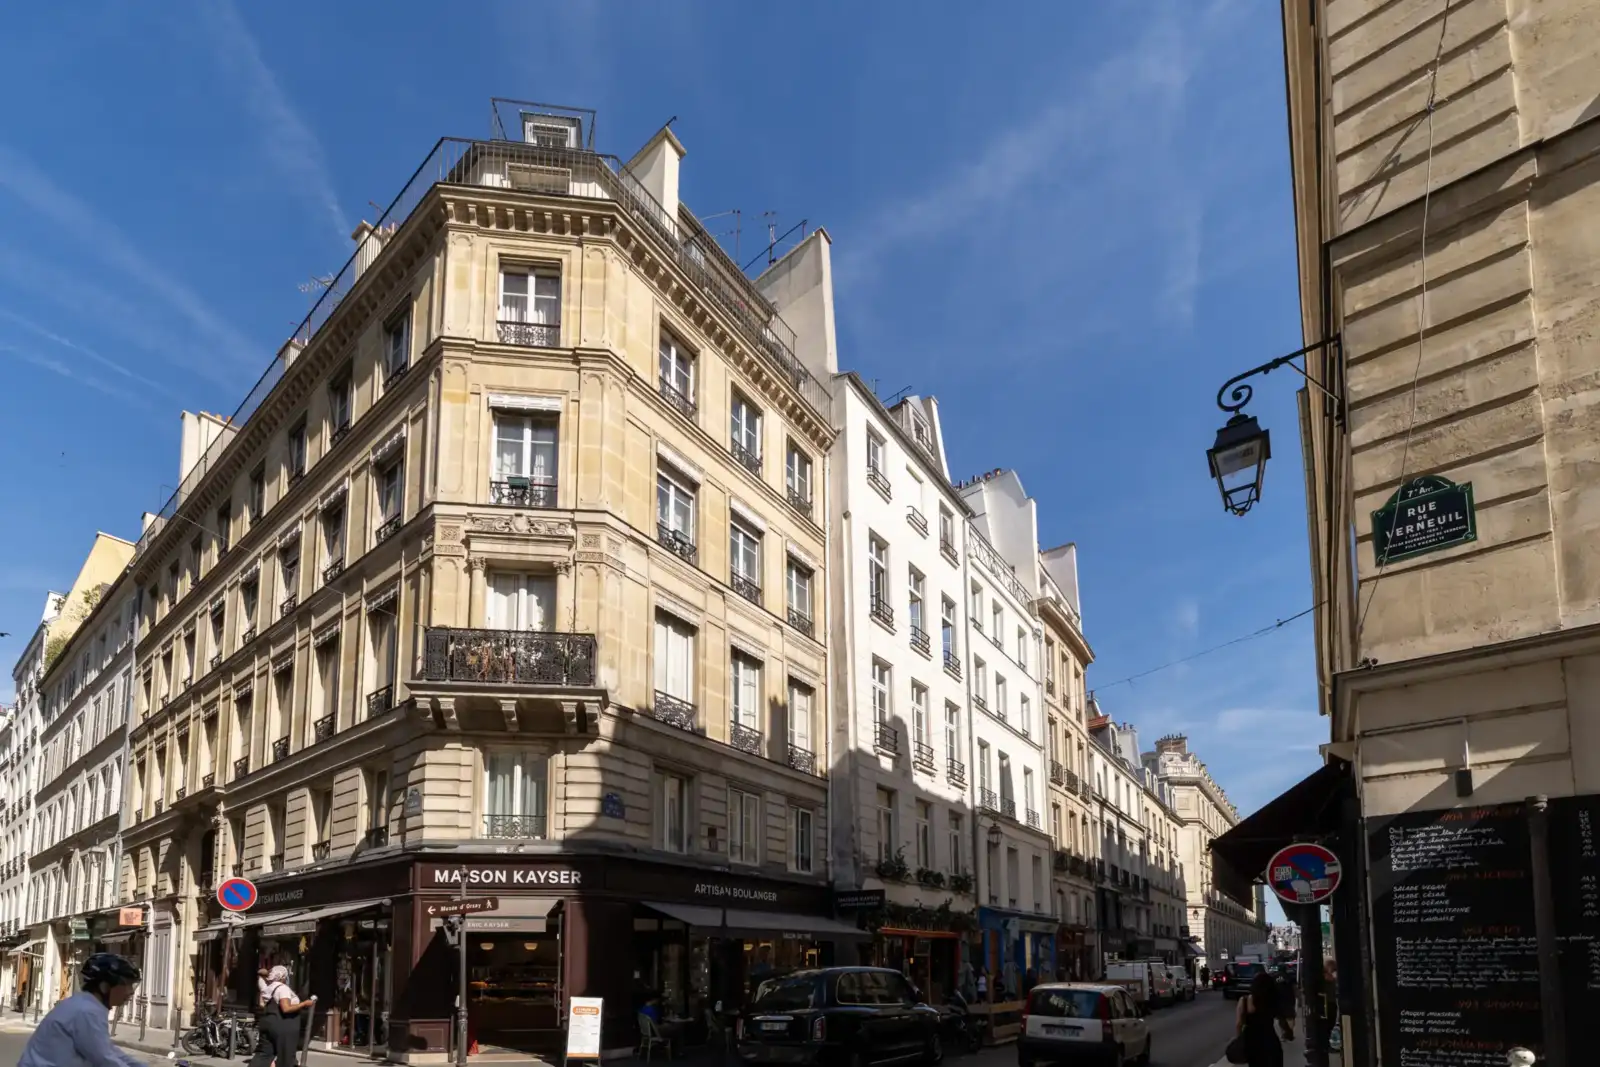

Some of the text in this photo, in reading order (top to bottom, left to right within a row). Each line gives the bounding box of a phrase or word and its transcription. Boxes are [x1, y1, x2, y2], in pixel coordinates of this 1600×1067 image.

[1407, 501, 1437, 517] RUE
[1385, 511, 1463, 537] VERNEUIL
[434, 869, 582, 884] MASON KAYSER
[694, 883, 778, 902] ARTISAN BOULANGER
